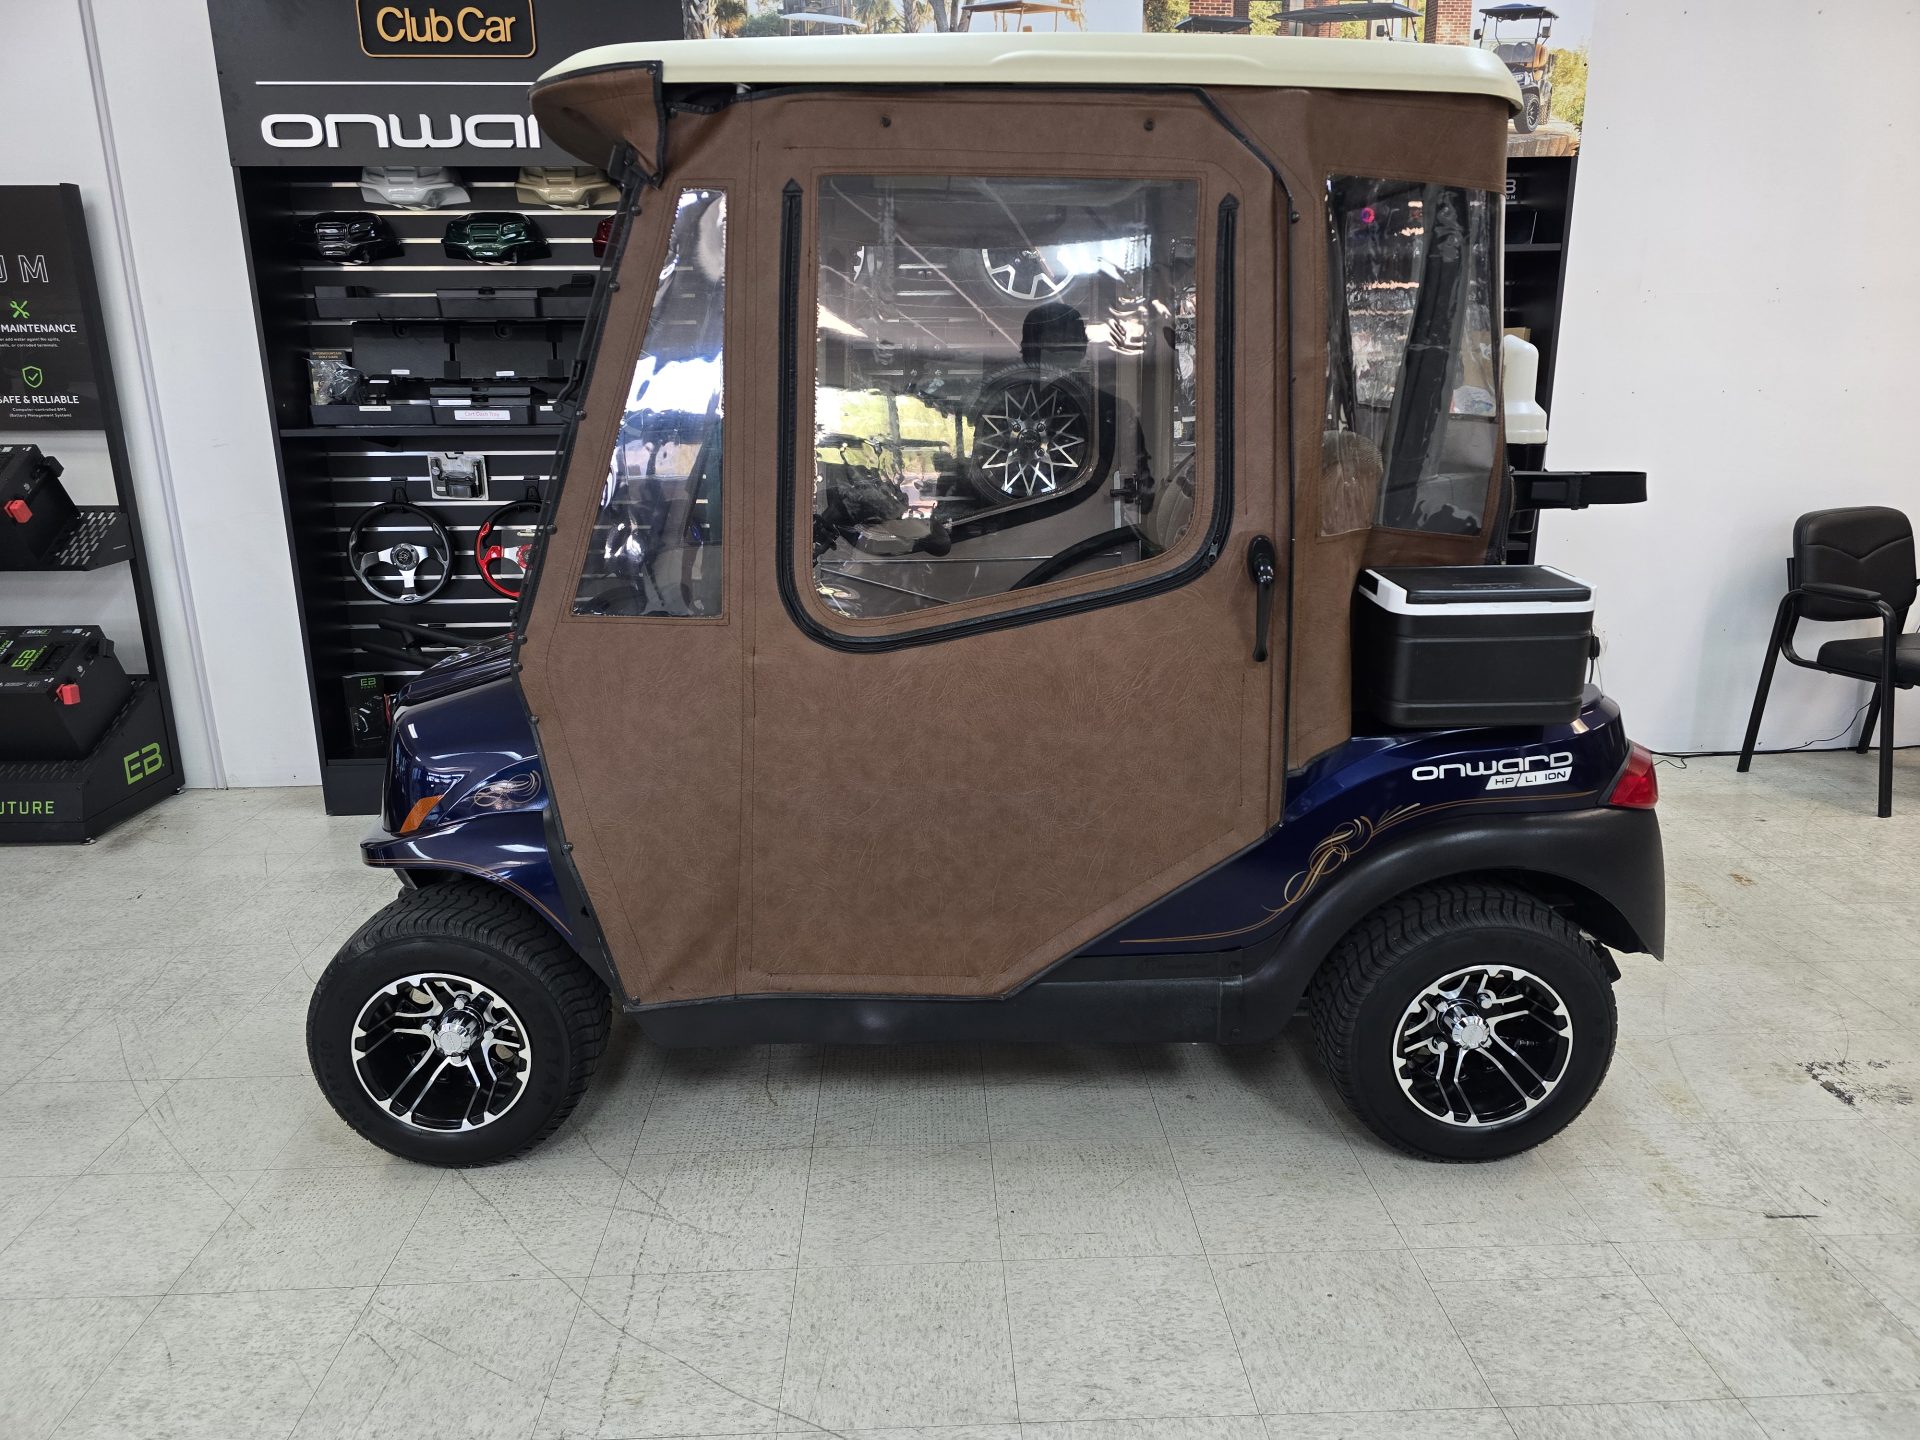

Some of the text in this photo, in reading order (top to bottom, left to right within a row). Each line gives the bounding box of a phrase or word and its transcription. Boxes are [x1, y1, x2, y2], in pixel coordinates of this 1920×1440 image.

[377, 6, 516, 43] Club Car
[261, 114, 541, 148] onwa
[0, 324, 77, 333] MAINTENANCE
[23, 395, 31, 403] &
[32, 395, 79, 403] RELIABLE
[123, 742, 163, 785] EB
[1495, 777, 1514, 785] HP
[1544, 770, 1566, 780] ION
